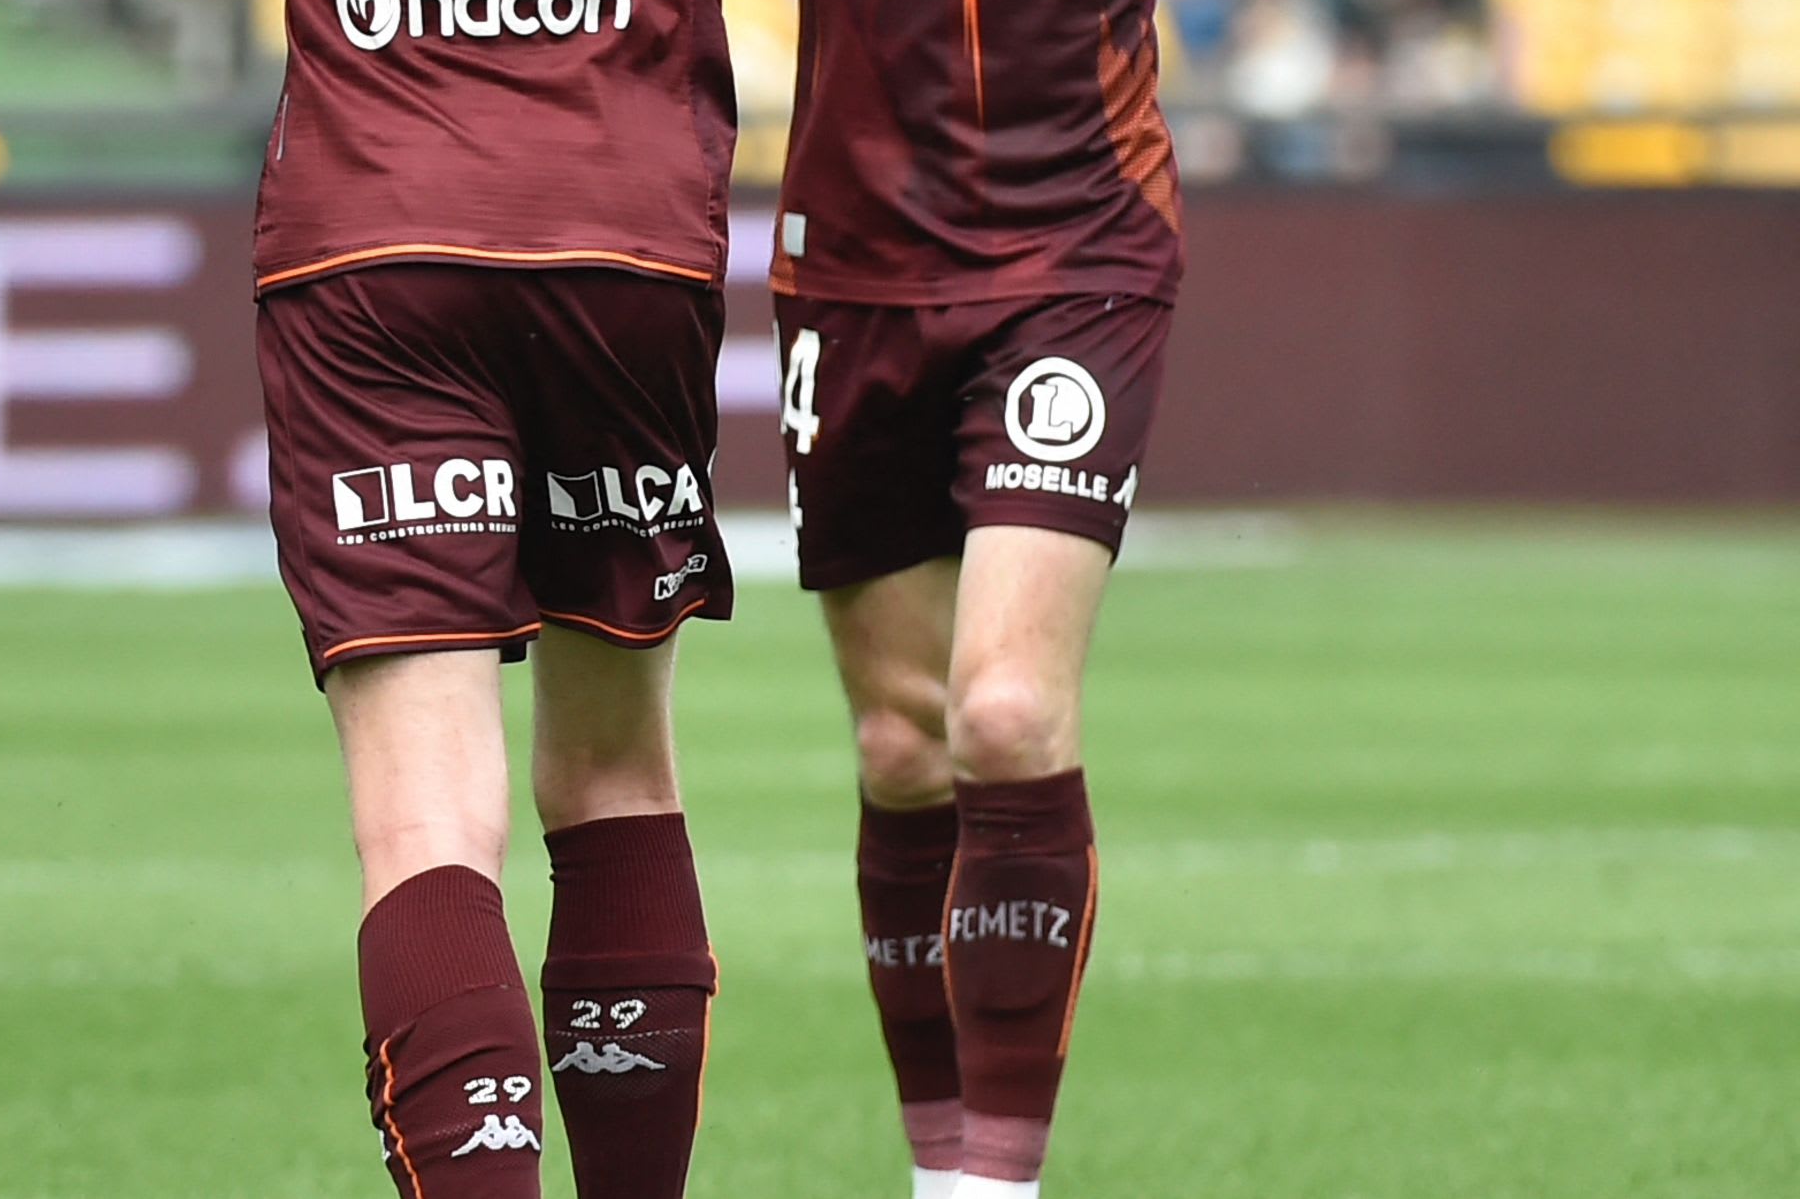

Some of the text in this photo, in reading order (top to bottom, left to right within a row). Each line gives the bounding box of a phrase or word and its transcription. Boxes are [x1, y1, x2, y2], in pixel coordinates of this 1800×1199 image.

[390, 458, 517, 521] LCR
[602, 462, 703, 521] LCR
[985, 462, 1109, 502] MOSELLE
[570, 999, 647, 1029] 29
[463, 1075, 532, 1104] 29
